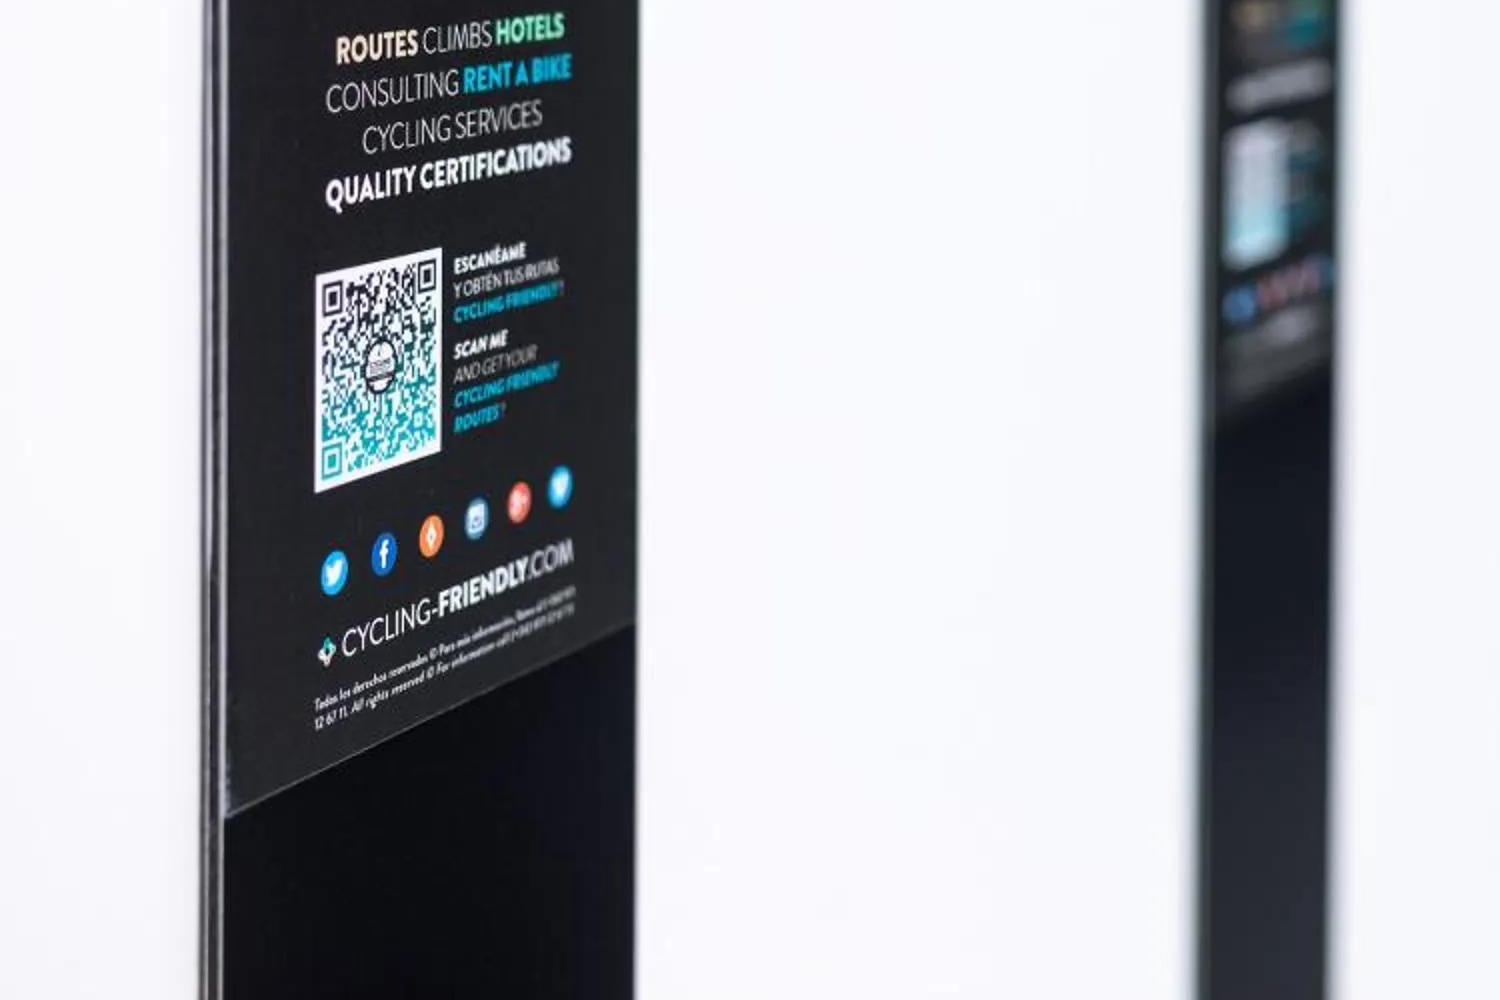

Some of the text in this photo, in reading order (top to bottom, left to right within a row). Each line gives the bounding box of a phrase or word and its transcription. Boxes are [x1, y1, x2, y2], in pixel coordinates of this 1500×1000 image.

[336, 12, 566, 65] ROUTES CLIMBS HOTELS
[325, 53, 572, 113] CONSULTING RENT A BIKE
[362, 98, 544, 155] CYCLING SERVICES
[325, 136, 573, 214] QUALITY CERTIFICATIONS
[453, 241, 527, 276] ESCANÉAME
[453, 280, 463, 299] Y
[453, 328, 510, 361] SCAN ME
[341, 537, 575, 658] CYCLING-FRIENDLY.COM
